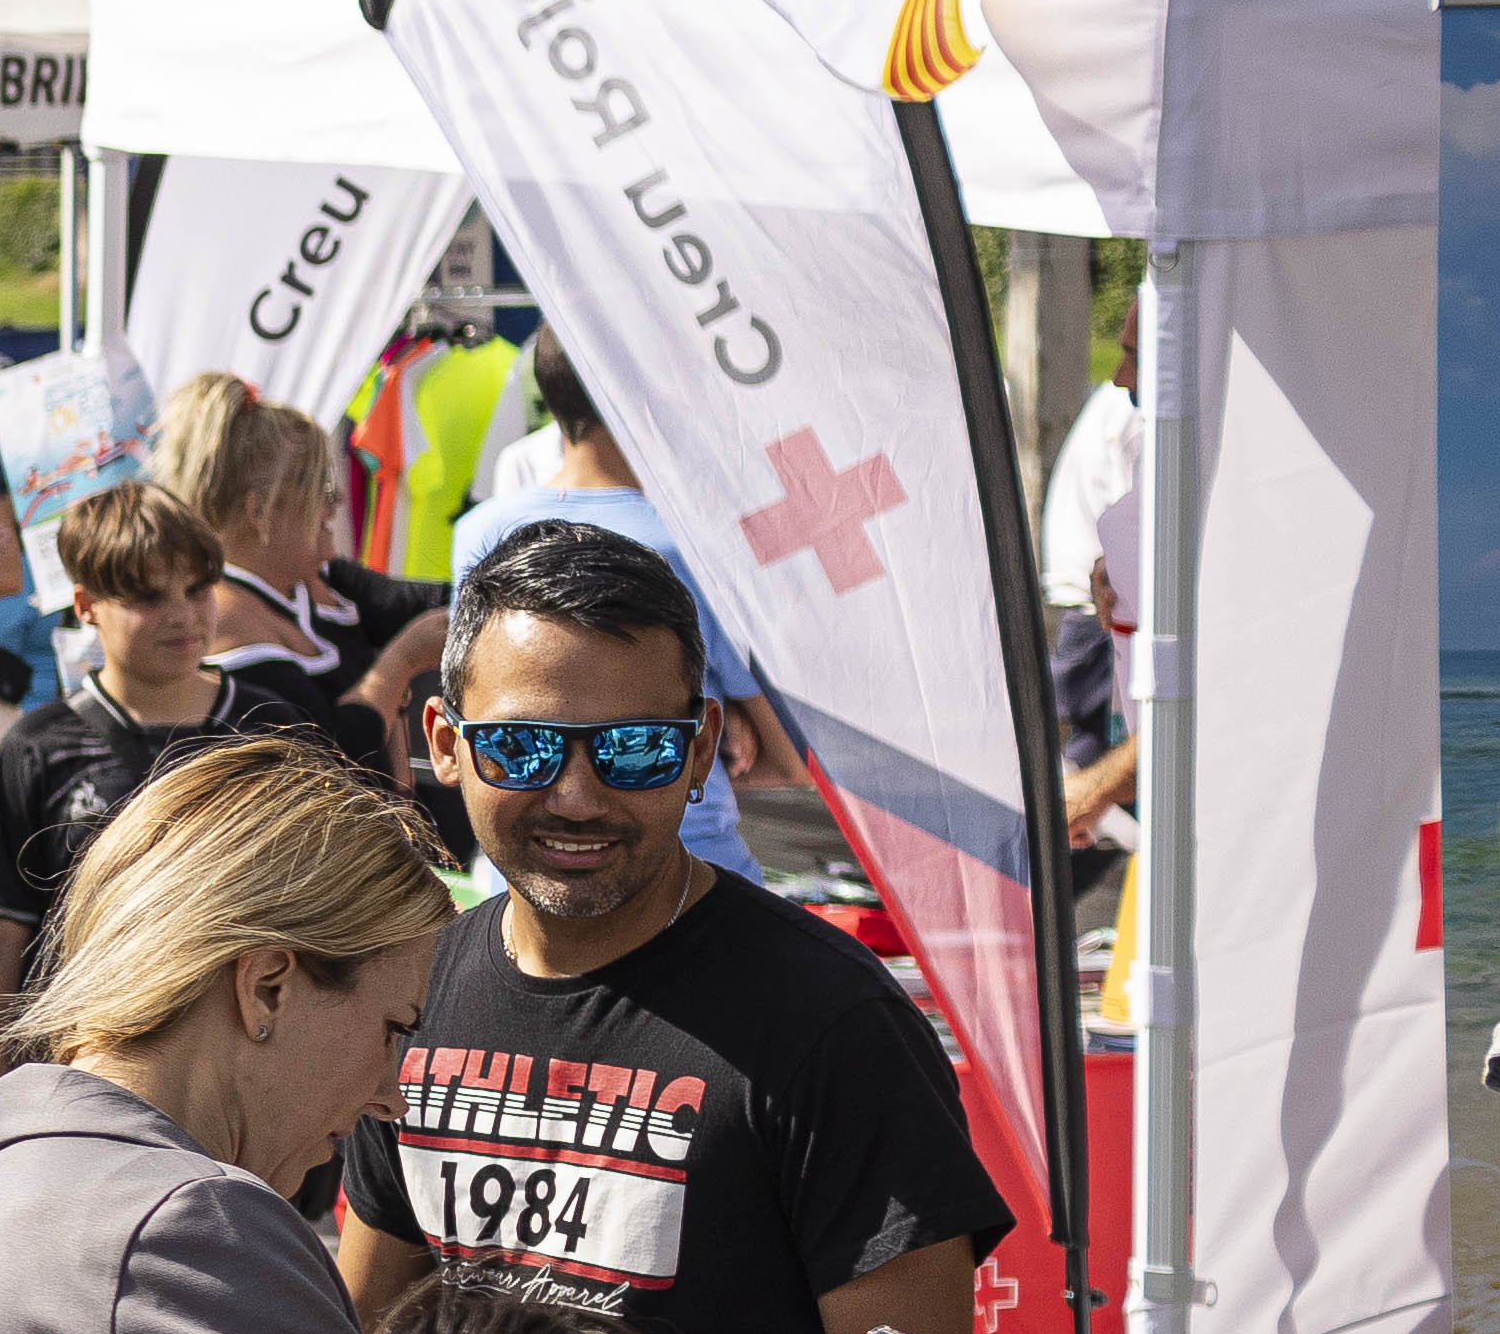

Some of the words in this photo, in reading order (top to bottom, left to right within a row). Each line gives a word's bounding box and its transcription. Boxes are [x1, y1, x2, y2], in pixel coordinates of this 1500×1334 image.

[250, 175, 369, 342] Creu
[397, 1047, 707, 1161] ATHLETIC
[440, 1161, 592, 1253] 1984
[520, 1263, 630, 1311] Apparel
